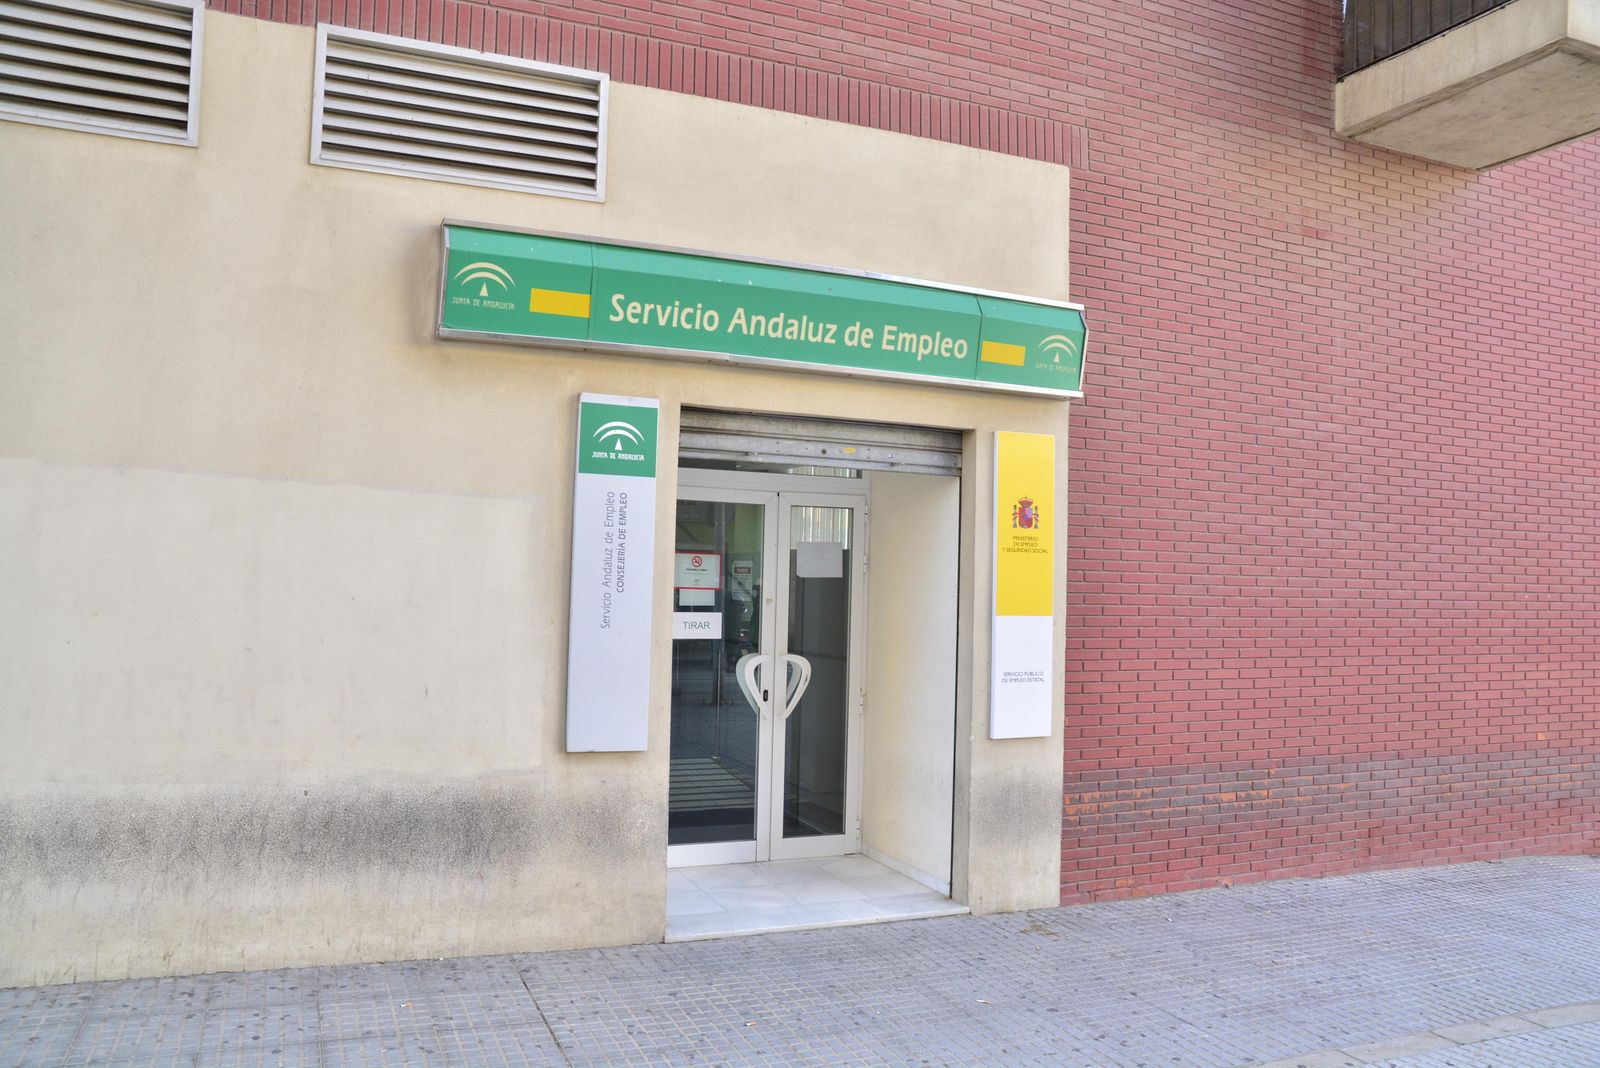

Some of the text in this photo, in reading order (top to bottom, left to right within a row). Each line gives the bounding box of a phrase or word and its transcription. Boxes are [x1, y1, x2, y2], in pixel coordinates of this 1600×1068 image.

[451, 297, 471, 305] JUNTA
[473, 299, 481, 307] DE
[609, 293, 968, 361] Servicio Andaluz de Empleo
[592, 451, 608, 459] JUNTA
[609, 452, 616, 460] DE
[619, 492, 628, 526] EMPLEO
[618, 528, 627, 540] DE
[600, 491, 617, 629] Servicio Andaluz de Empleo
[682, 621, 711, 630] TIRAR
